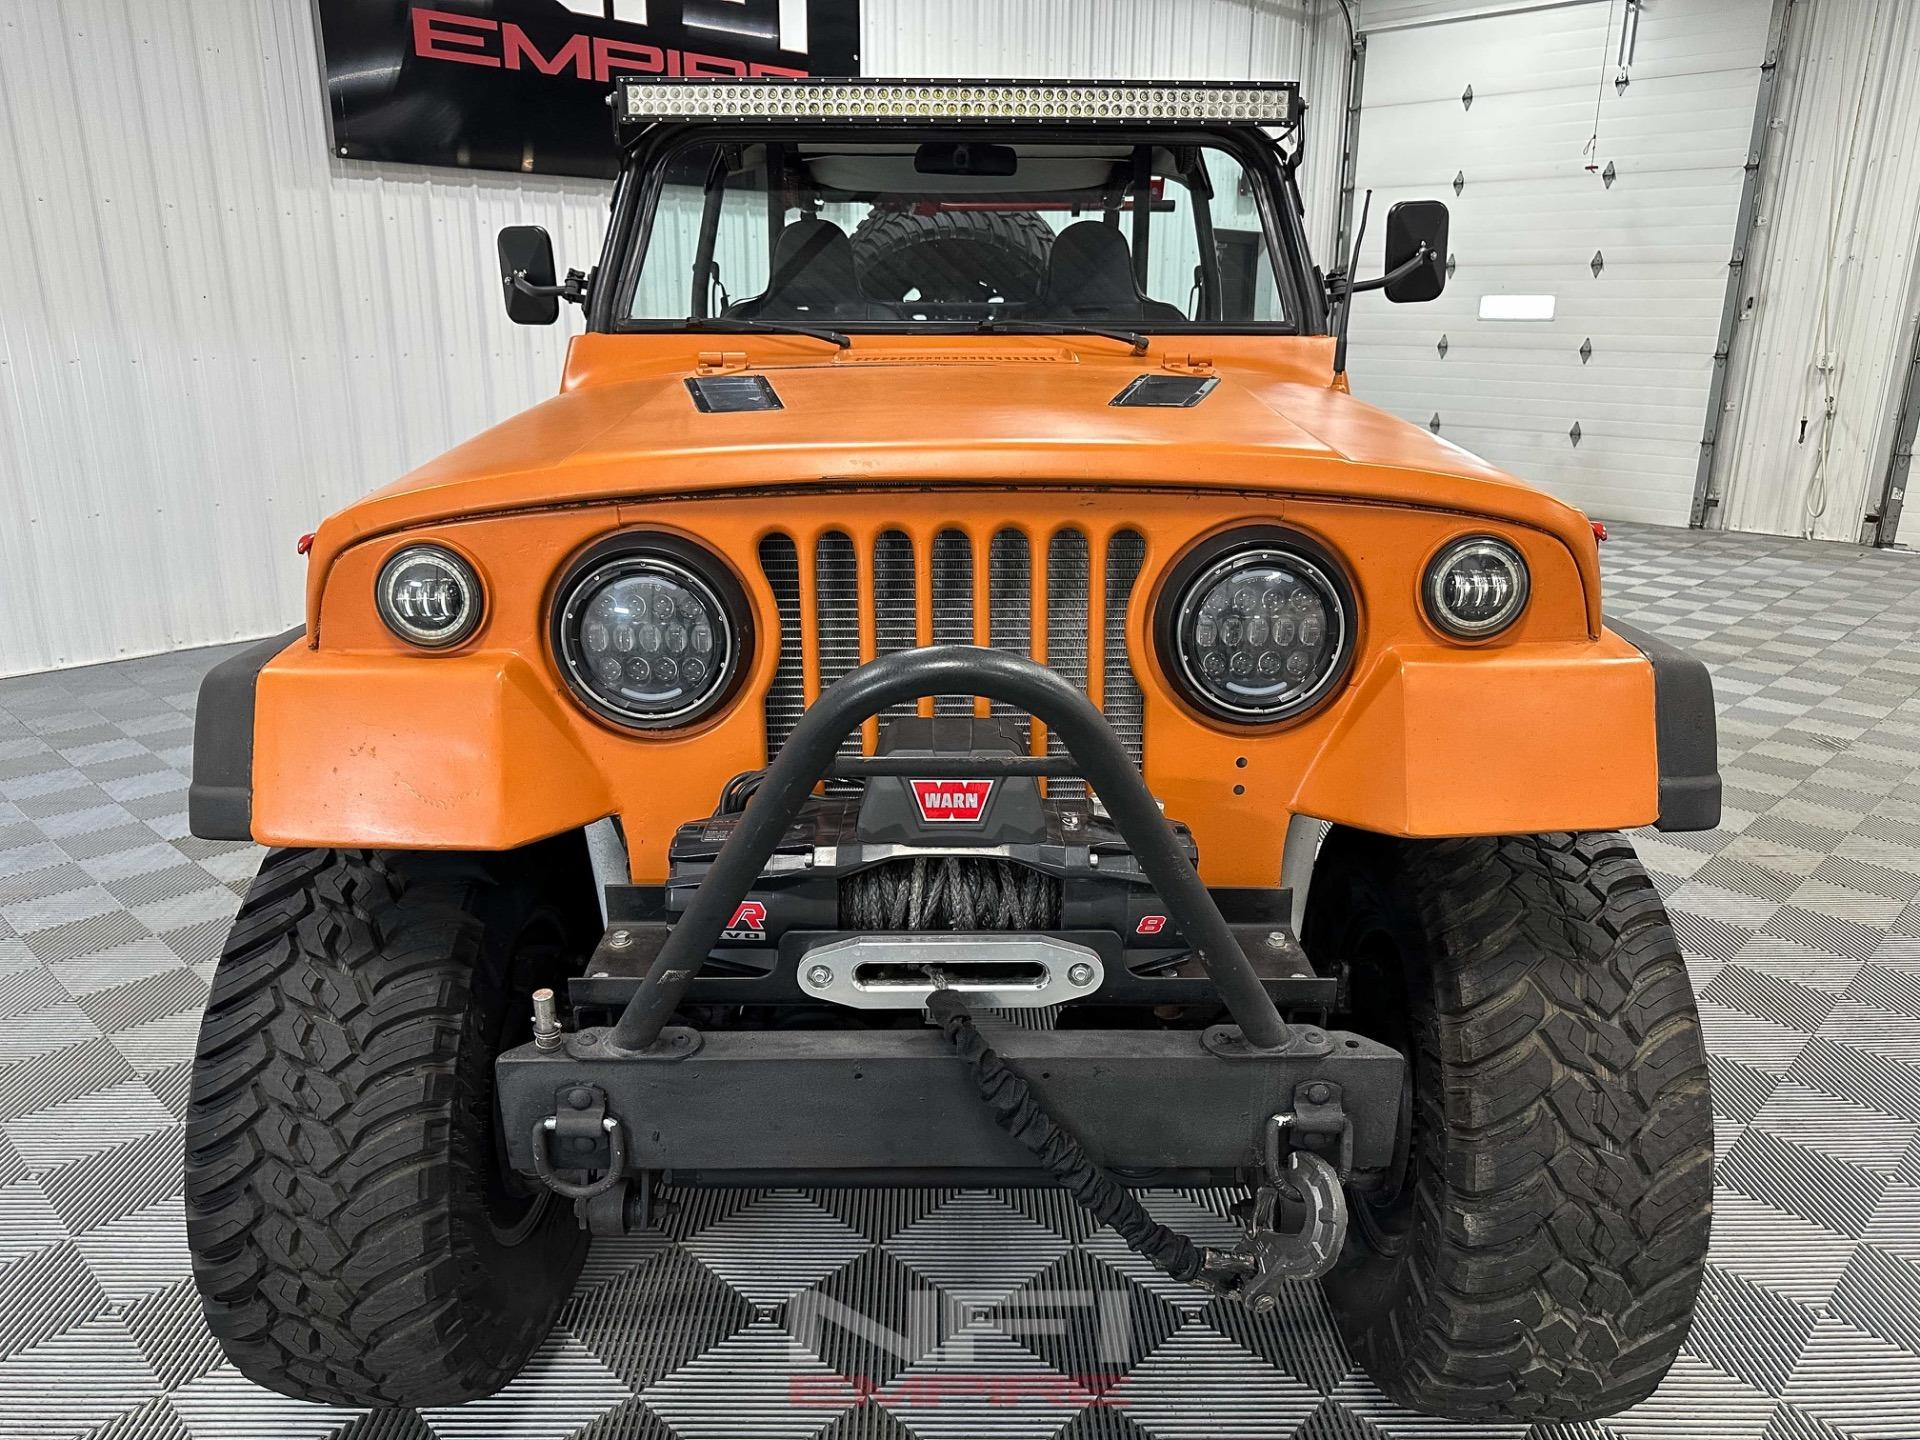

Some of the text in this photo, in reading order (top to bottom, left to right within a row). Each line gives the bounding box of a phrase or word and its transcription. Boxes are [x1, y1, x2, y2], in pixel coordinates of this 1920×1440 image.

[924, 792, 978, 809] WARN
[1136, 915, 1168, 935] 8
[719, 930, 766, 941] VO
